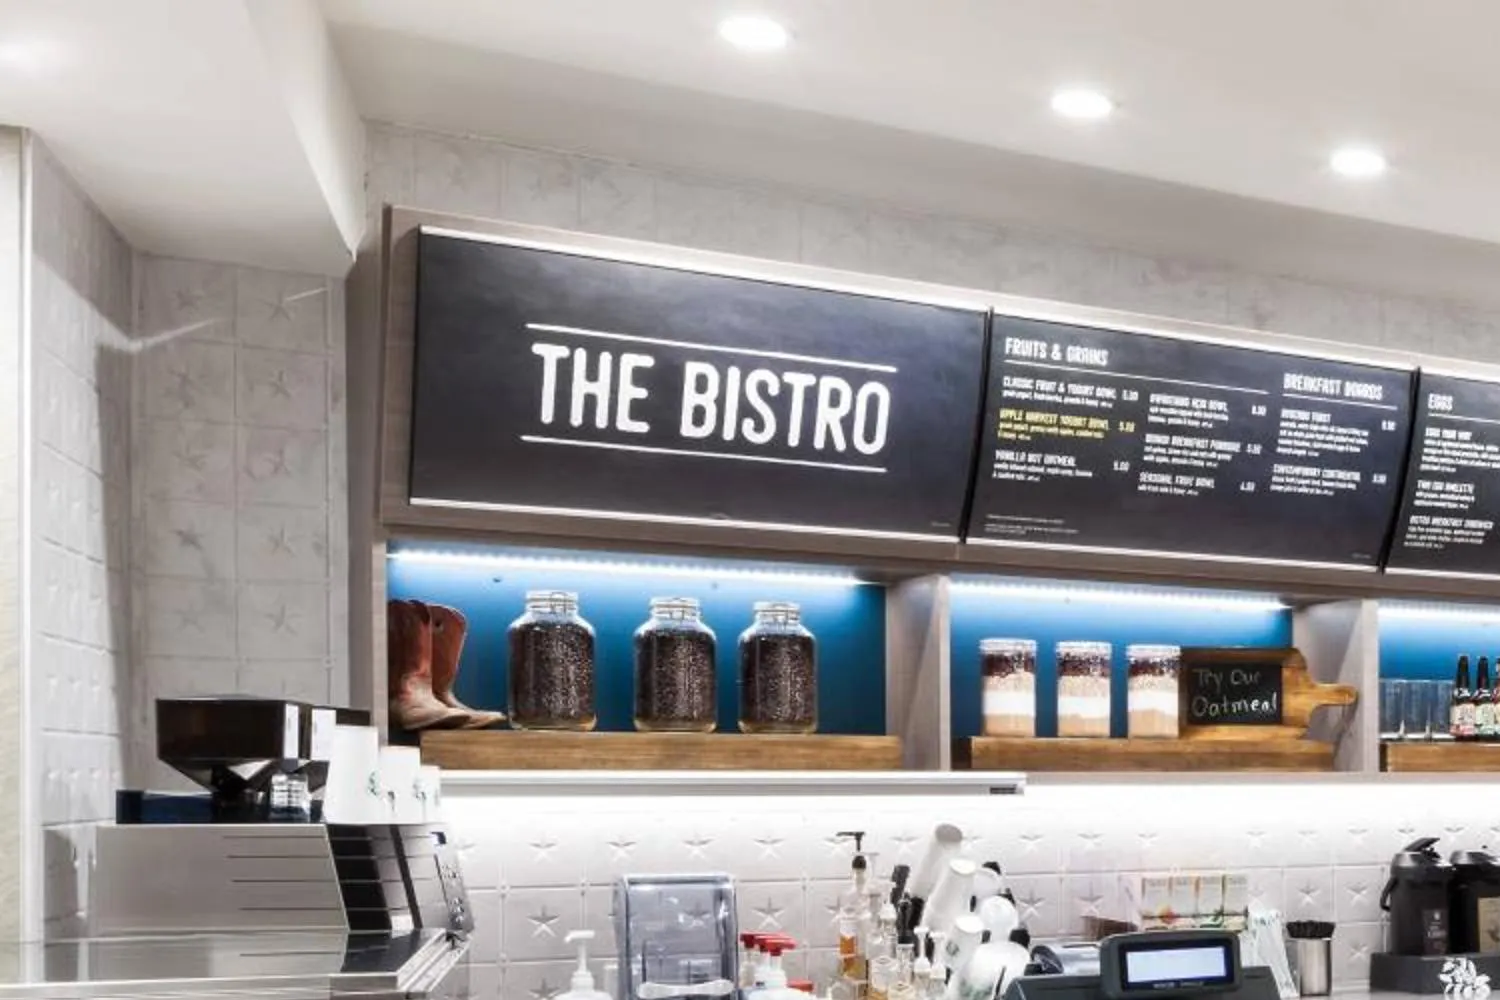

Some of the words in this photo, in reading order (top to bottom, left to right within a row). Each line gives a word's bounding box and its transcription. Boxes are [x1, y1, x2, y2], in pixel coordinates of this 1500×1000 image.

[1005, 337, 1047, 359] FRUITS
[1051, 343, 1061, 361] &
[1066, 345, 1108, 366] GRAINS
[1283, 373, 1342, 396] BREAKFAST
[531, 342, 655, 433] THE
[680, 361, 891, 455] BISTRO
[1192, 669, 1224, 696] Try
[1231, 669, 1261, 685] Our
[1191, 691, 1277, 718] Oatmeal
